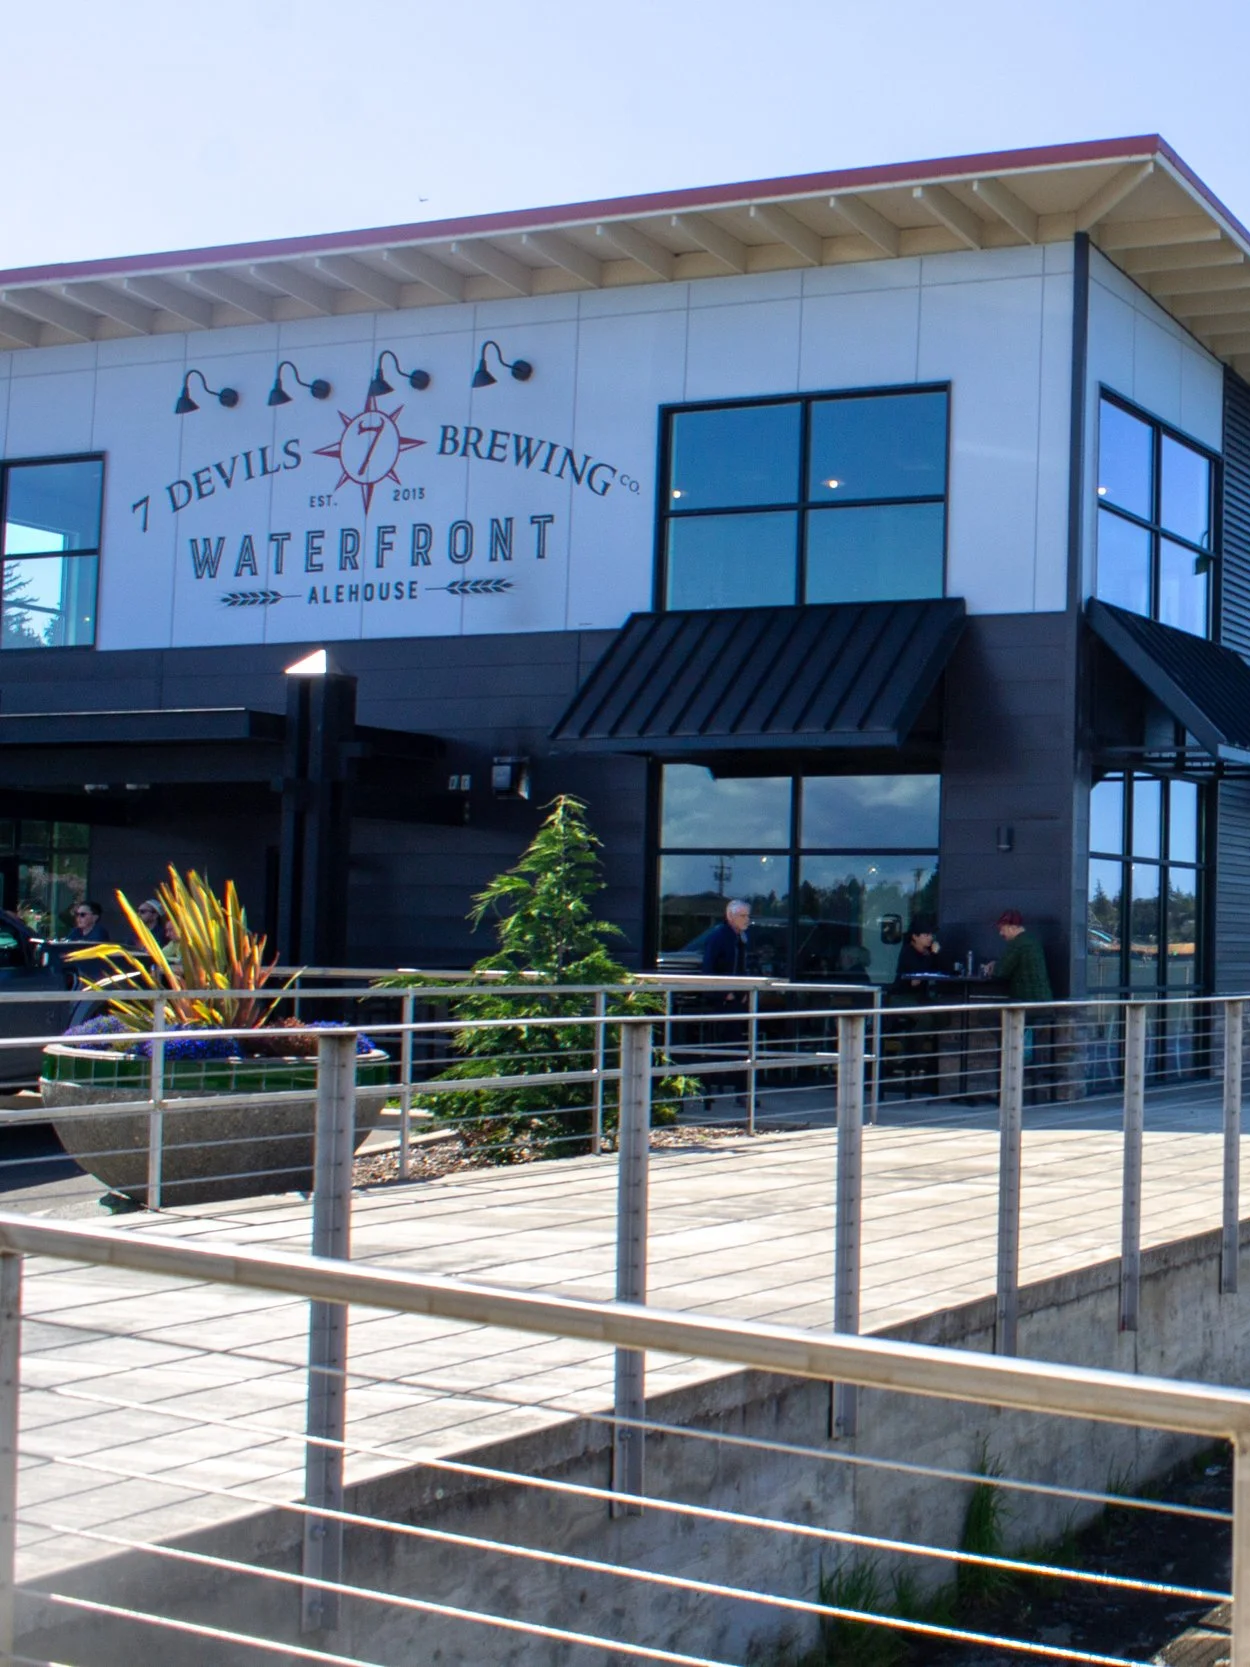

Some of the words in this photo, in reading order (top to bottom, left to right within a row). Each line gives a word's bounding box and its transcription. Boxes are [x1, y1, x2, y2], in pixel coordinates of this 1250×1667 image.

[358, 416, 385, 476] 7
[132, 495, 150, 533] 7
[165, 438, 302, 513] DEVILS
[436, 424, 618, 497] BREWING
[619, 473, 641, 496] CO.
[309, 494, 338, 508] EST.
[393, 487, 425, 502] 2013
[189, 514, 554, 580] WATERFRONT
[308, 581, 418, 605] ALEHOUSE
